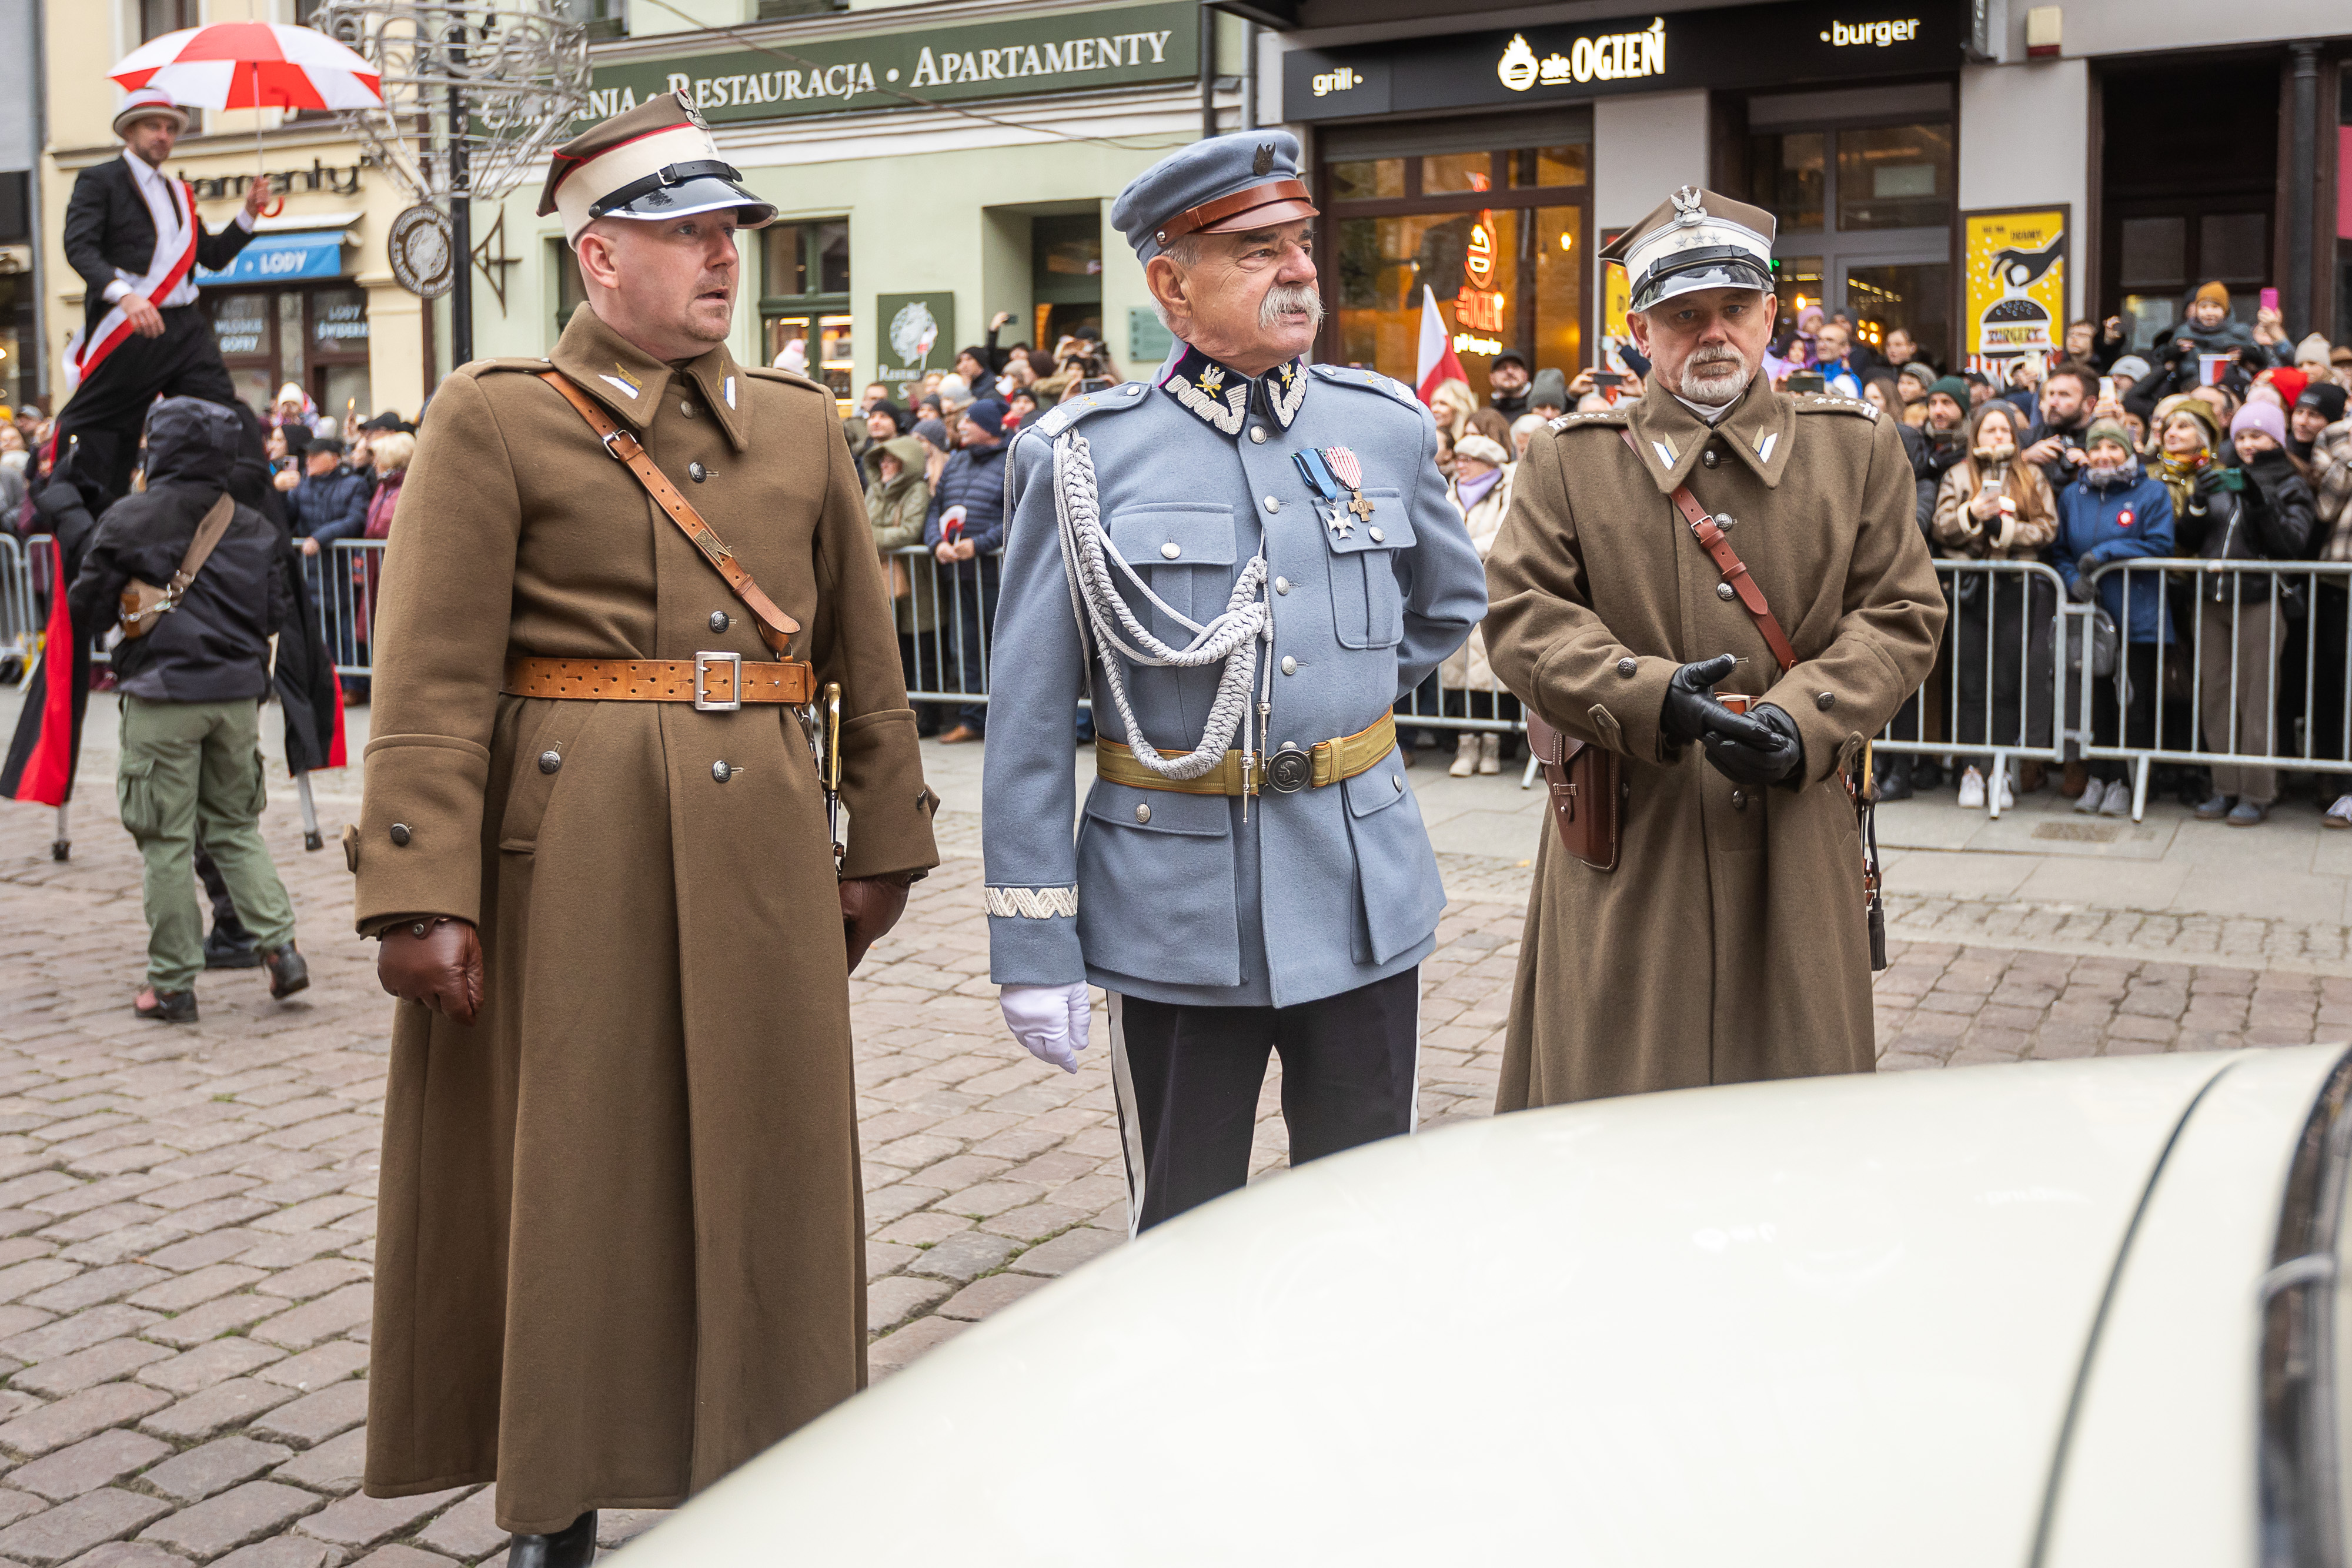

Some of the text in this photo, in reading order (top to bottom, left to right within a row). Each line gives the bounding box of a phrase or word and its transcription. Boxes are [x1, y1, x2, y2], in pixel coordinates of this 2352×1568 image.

[1832, 18, 1920, 47] burger
[1571, 16, 1666, 82] OGIEŃ
[667, 61, 877, 109] RESTAURACJA
[909, 29, 1172, 88] APARTAMENTY
[1312, 66, 1353, 97] grill
[260, 250, 308, 275] LODY
